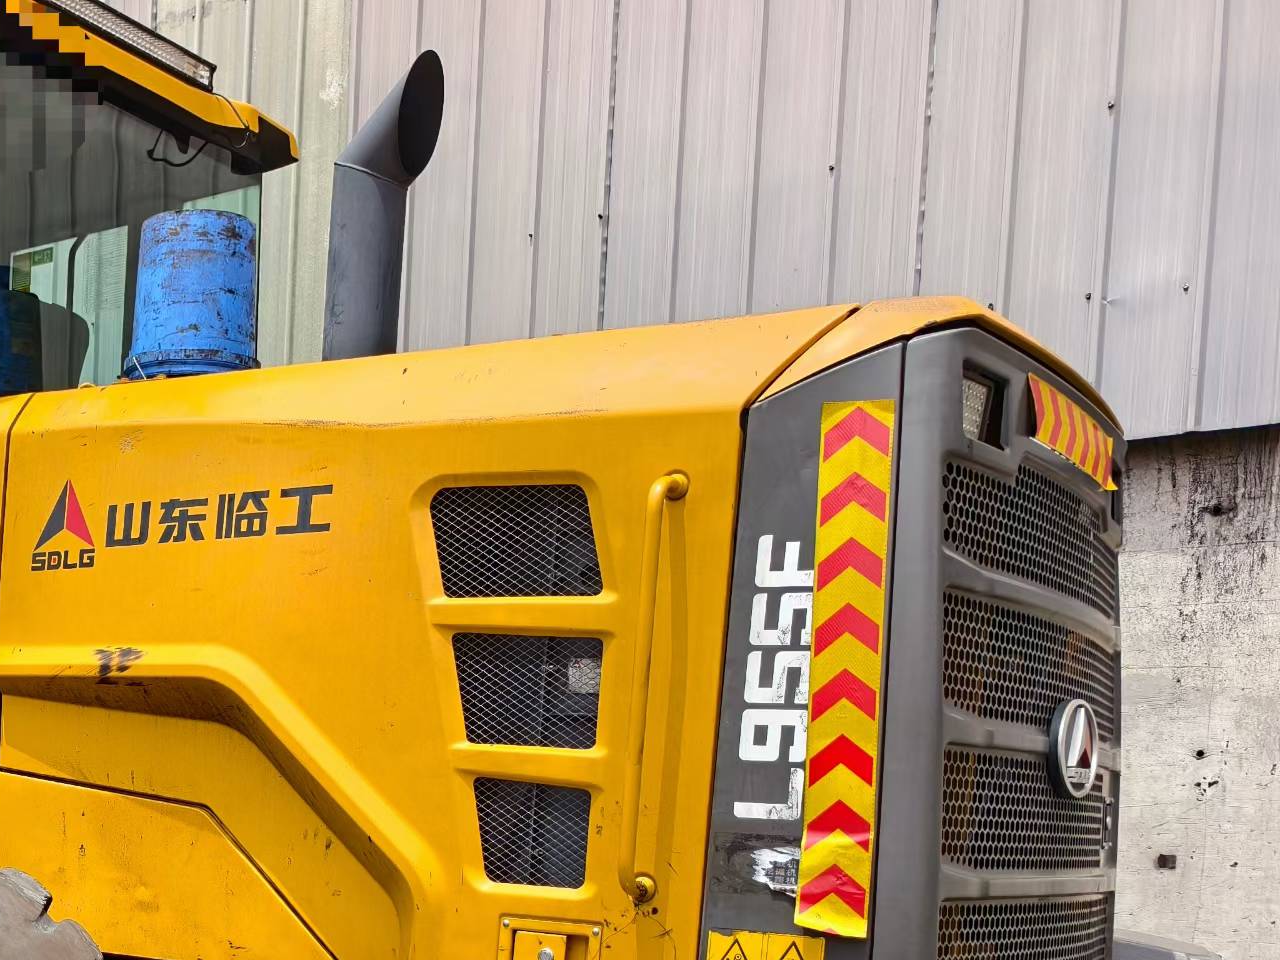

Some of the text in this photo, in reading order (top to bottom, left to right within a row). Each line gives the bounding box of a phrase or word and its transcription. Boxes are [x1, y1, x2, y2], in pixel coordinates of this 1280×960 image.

[105, 484, 333, 547] 山东临工
[31, 548, 95, 571] SDLG
[733, 535, 814, 820] L955F
